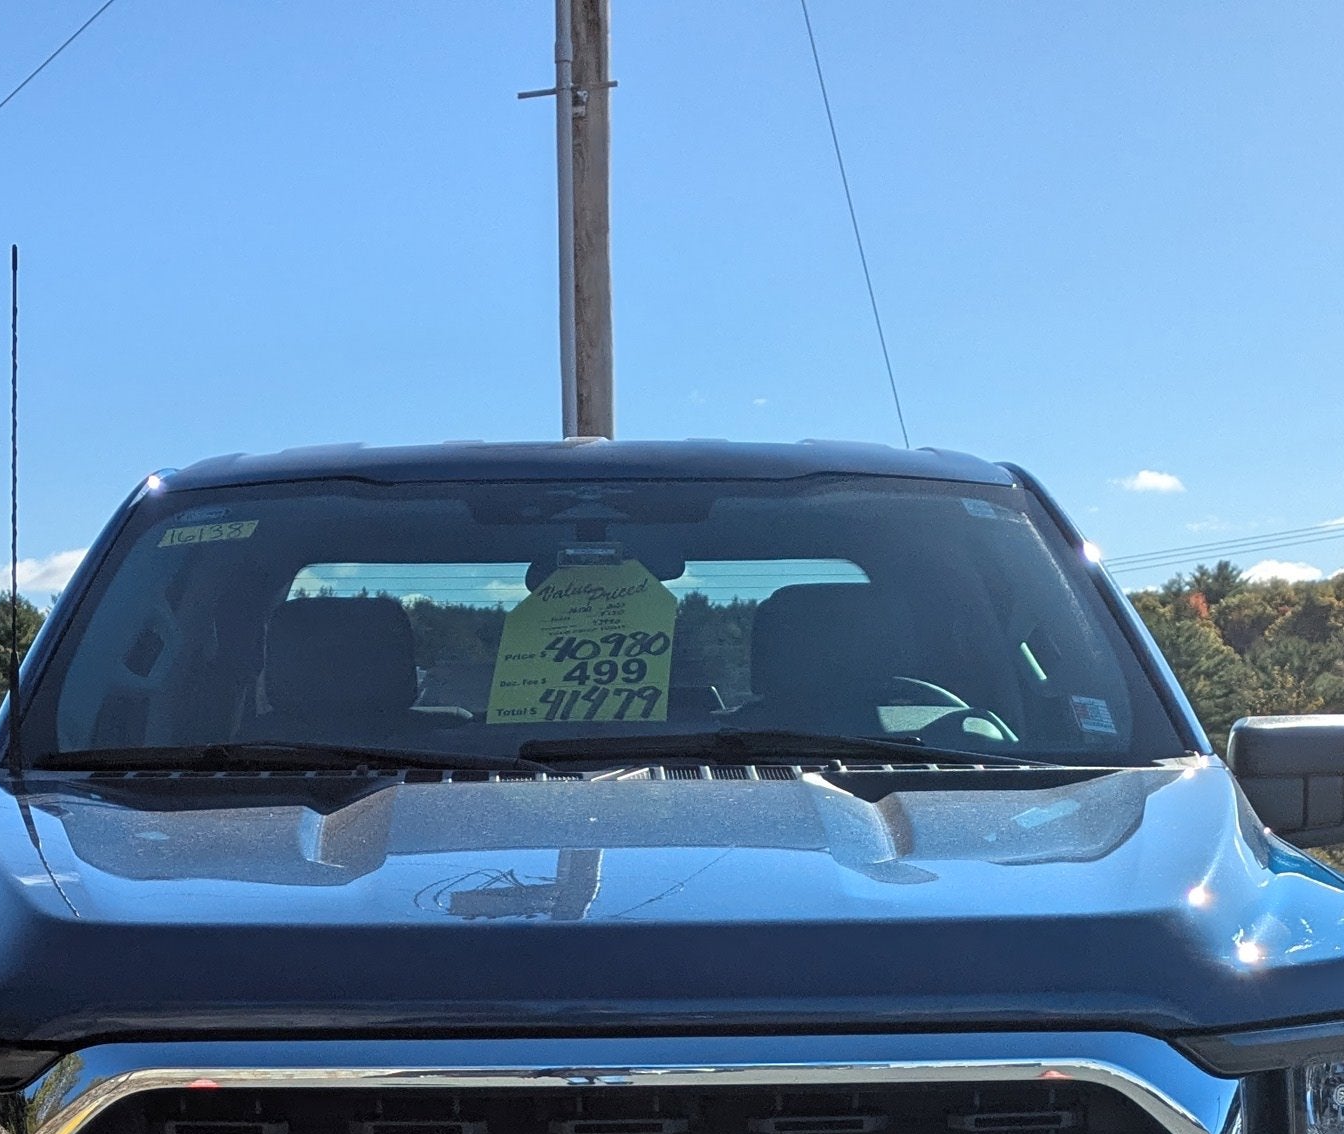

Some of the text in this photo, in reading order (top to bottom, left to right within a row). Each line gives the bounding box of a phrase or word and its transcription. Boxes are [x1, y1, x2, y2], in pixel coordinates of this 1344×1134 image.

[545, 631, 670, 663] 40980
[562, 658, 648, 686] 499
[539, 686, 663, 720] 41479
